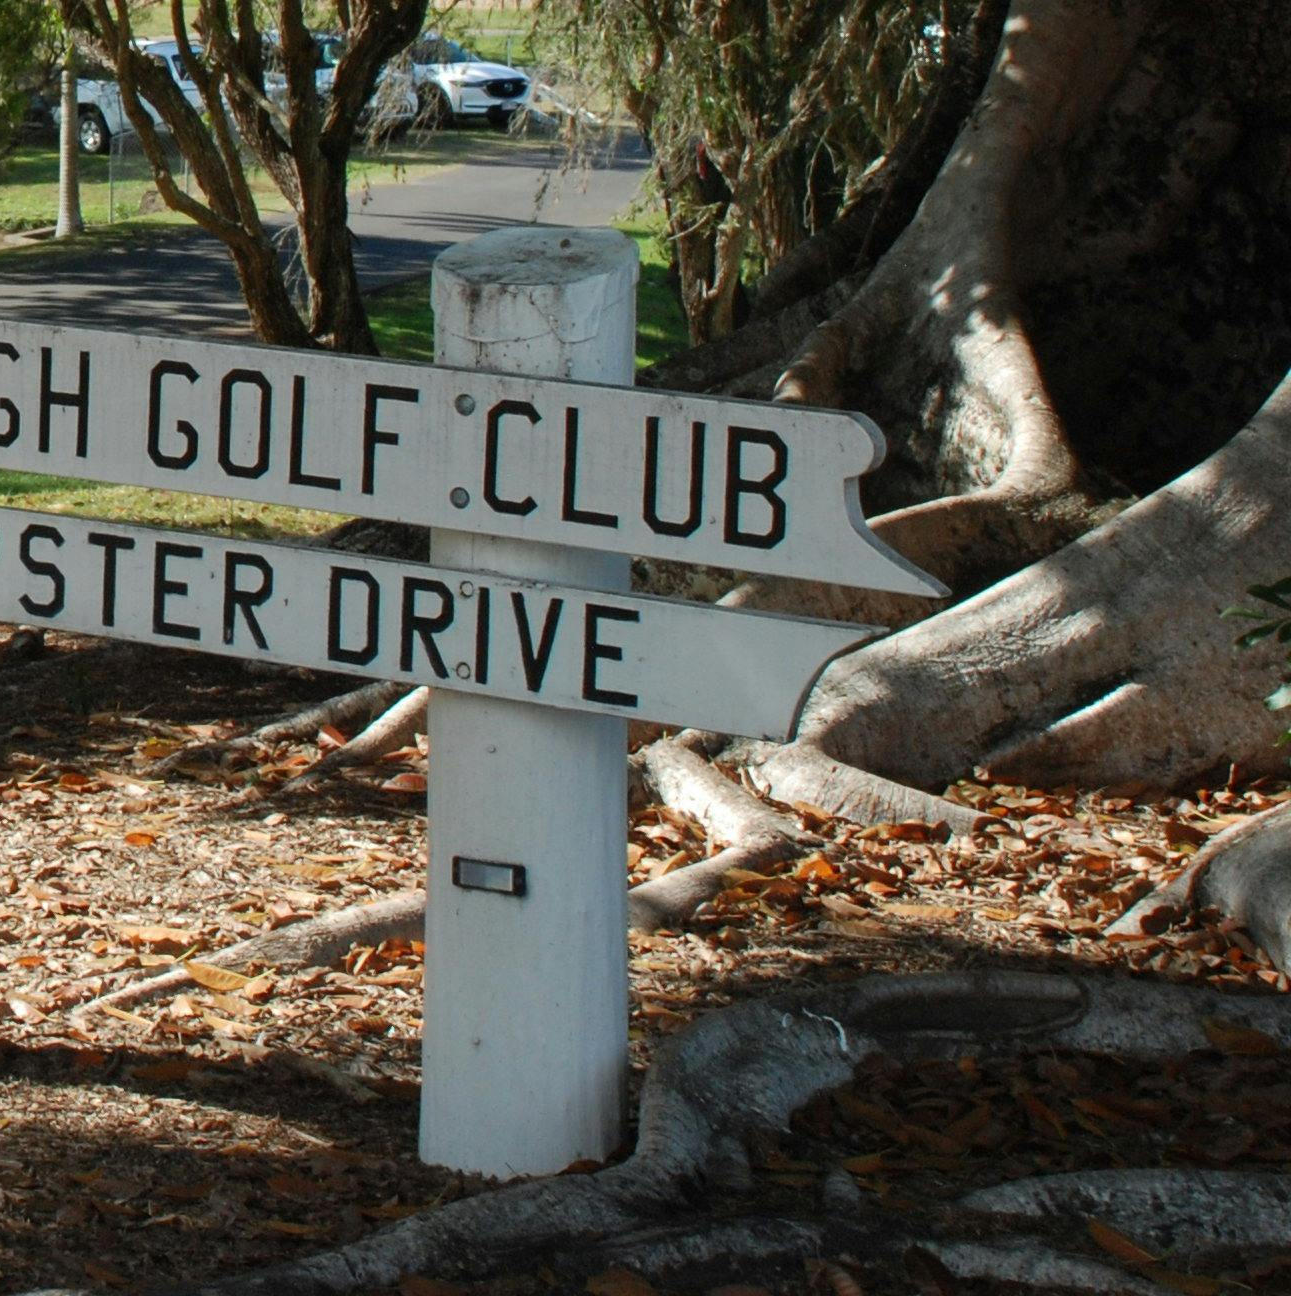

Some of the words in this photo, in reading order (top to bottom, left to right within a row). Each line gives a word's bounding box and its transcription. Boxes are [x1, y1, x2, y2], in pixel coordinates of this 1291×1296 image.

[147, 359, 420, 496] GOLF
[483, 399, 789, 550] CLUB
[327, 565, 640, 707] DRIVE
